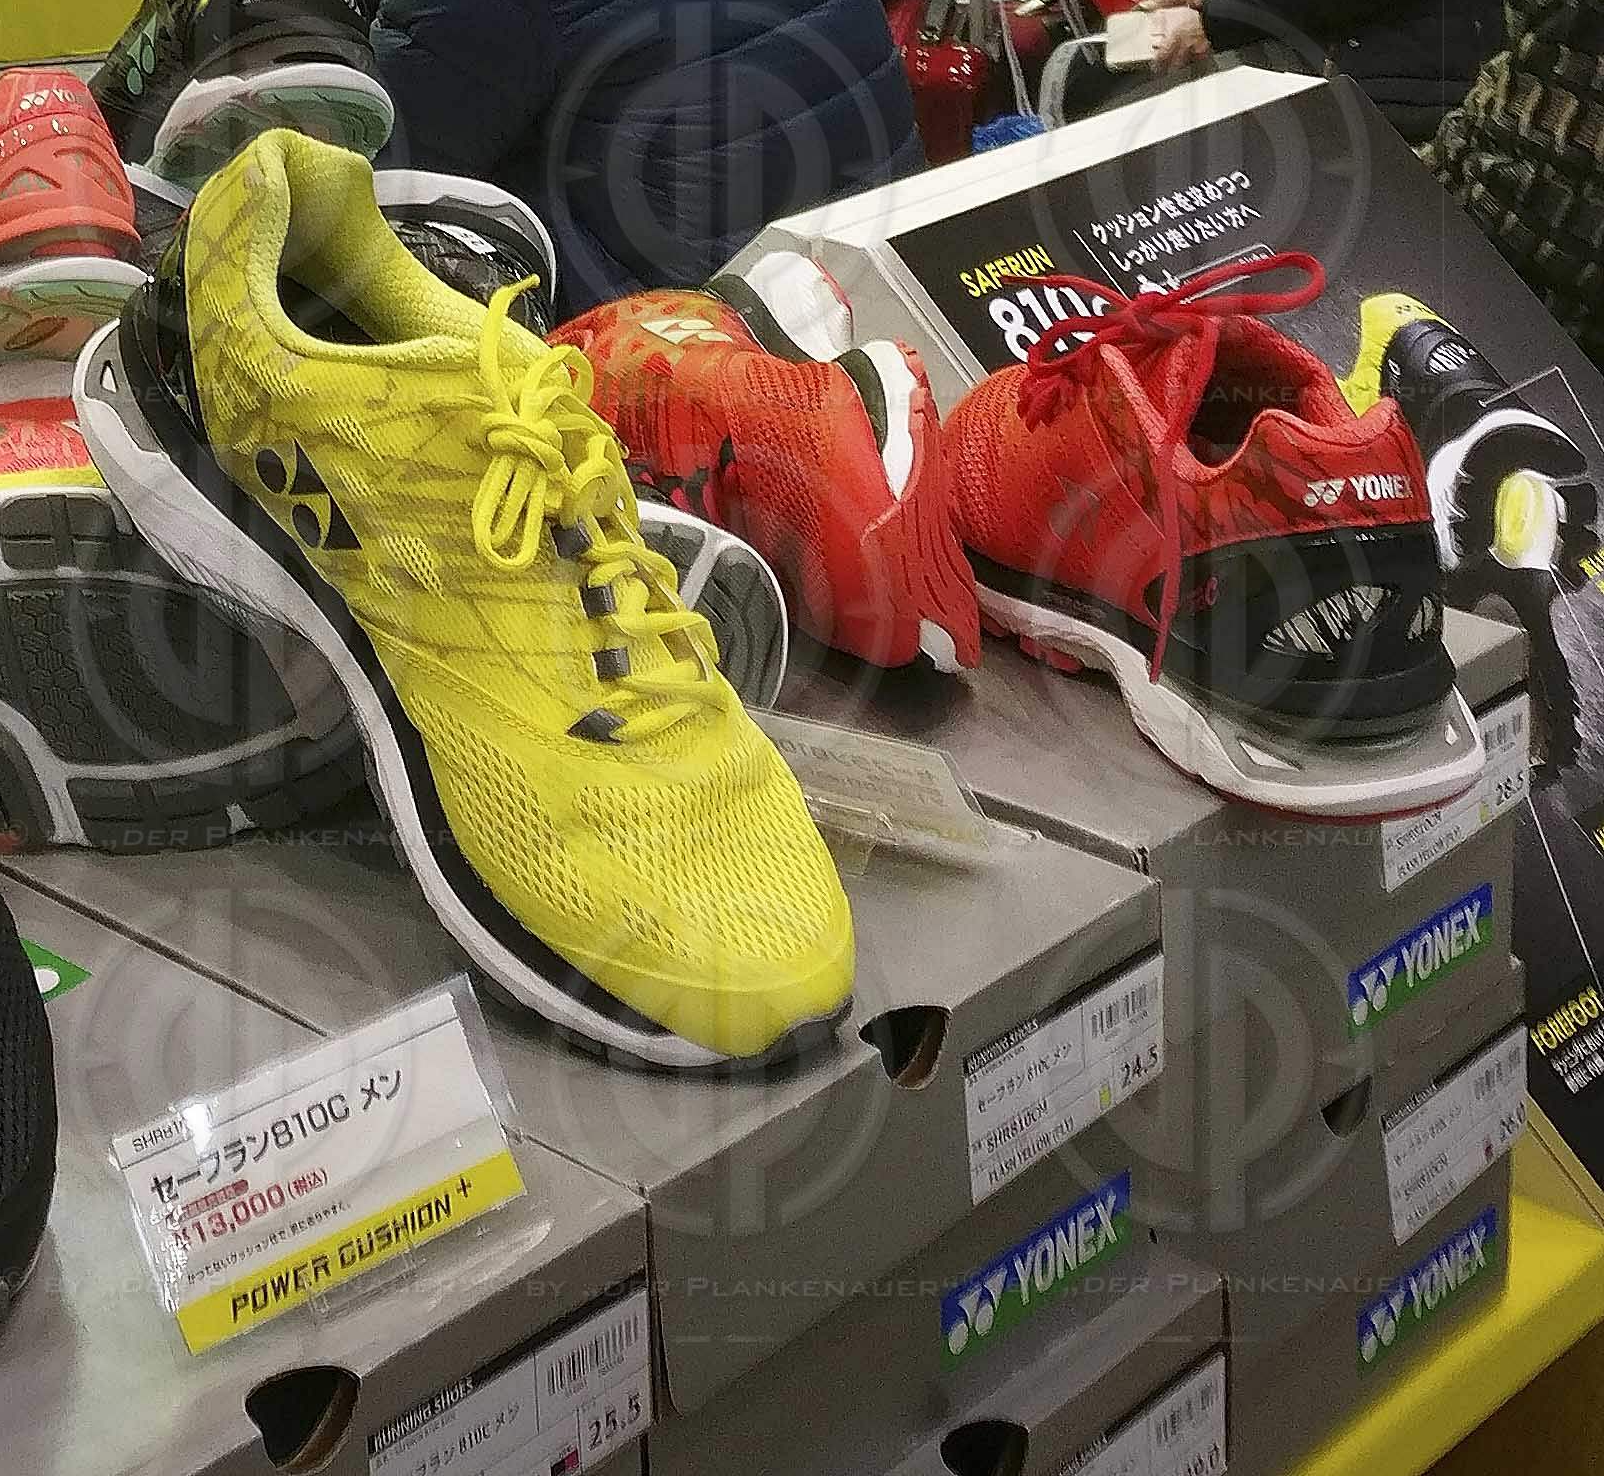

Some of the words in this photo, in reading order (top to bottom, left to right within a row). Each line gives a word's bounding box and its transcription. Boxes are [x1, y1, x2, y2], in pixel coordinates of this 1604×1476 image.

[1090, 169, 1252, 245] クッション性を求めつつ
[1108, 203, 1263, 272] しっかり走りたい方へ
[959, 243, 1056, 299] SAFERUN
[1348, 473, 1414, 502] YONEX
[1400, 900, 1483, 988] YONEX
[360, 1069, 402, 1112] メン
[1121, 1042, 1158, 1088] 24.5
[230, 1253, 332, 1324] POWER
[338, 1193, 453, 1271] CUSHION
[1012, 1193, 1119, 1307] YONEX
[1412, 1226, 1489, 1320] YONEX
[587, 1390, 644, 1452] 25.5
